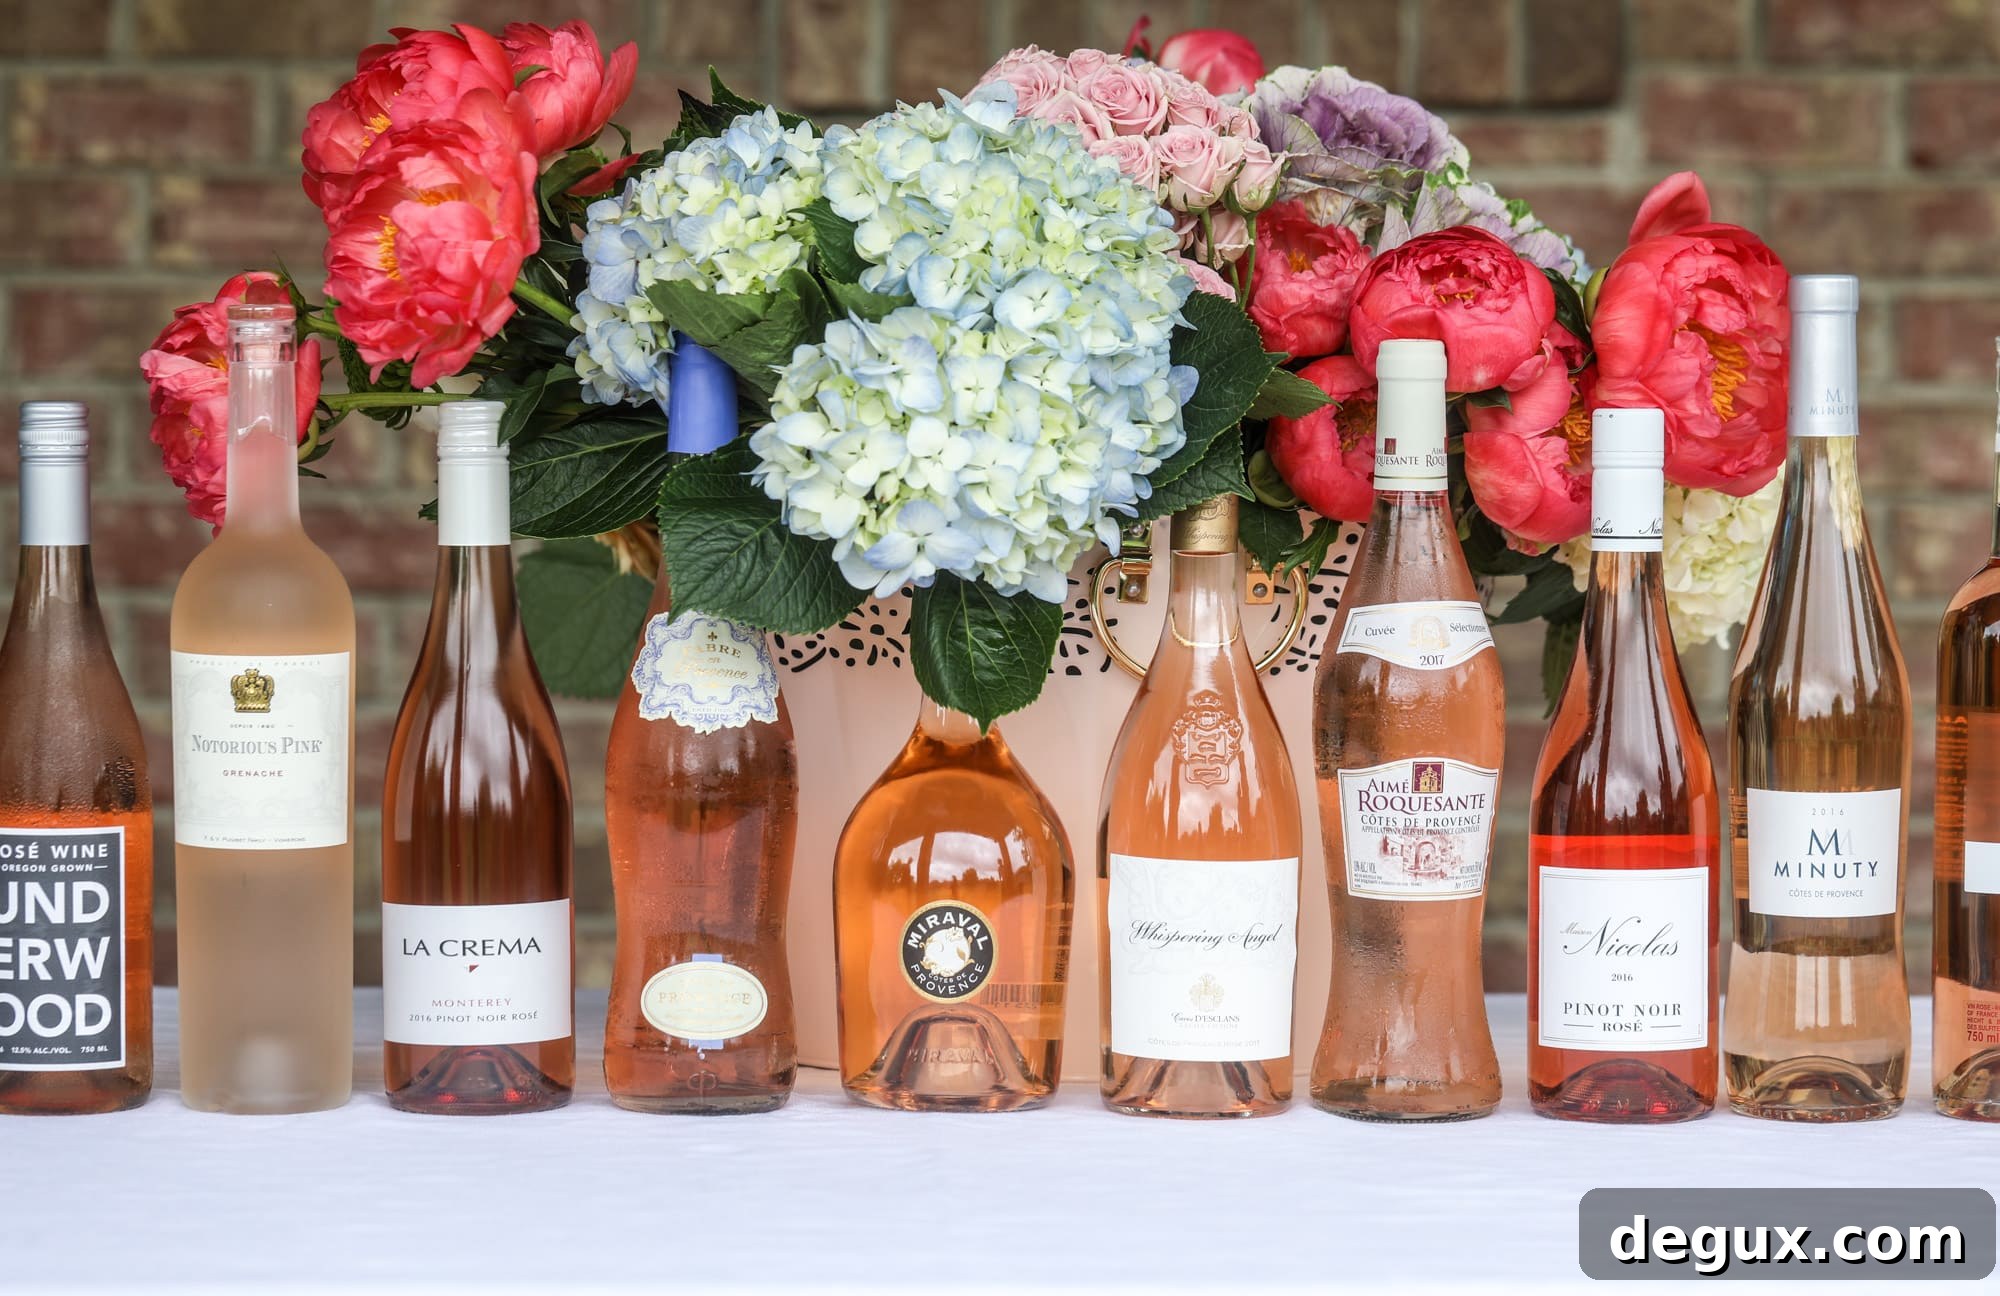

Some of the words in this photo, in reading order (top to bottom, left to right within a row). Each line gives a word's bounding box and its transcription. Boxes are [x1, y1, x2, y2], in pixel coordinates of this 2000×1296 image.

[1364, 626, 1396, 637] Cuvée
[1419, 655, 1445, 666] 2017
[192, 735, 277, 754] NOTORIOUS
[282, 736, 321, 754] PINK
[222, 769, 284, 777] GRENACHE
[1367, 778, 1409, 794] AIMÉ
[1358, 789, 1486, 815] ROQUESANTE
[1811, 808, 1845, 816] 2016
[1361, 814, 1398, 827] CÔTES
[1404, 818, 1419, 828] DE
[1425, 814, 1481, 828] PROVENCE
[50, 844, 108, 859] WINE
[1, 864, 46, 873] OREGON
[1774, 861, 1878, 879] MINUTY
[1814, 890, 1824, 898] DE
[1826, 889, 1864, 898] PROVENCE
[907, 911, 989, 951] MIRAVAL
[1128, 919, 1224, 951] Whispering
[1228, 922, 1284, 951] Angel
[1563, 916, 1680, 957] Nicolas
[403, 938, 431, 956] LA
[439, 937, 542, 957] CREMA
[911, 963, 985, 995] PROVENCE
[1611, 973, 1634, 982] 2016
[431, 998, 512, 1008] MONTEREY
[1563, 1002, 1624, 1017] PINOT
[1634, 1003, 1681, 1017] NOIR
[409, 1013, 432, 1022] 2016
[436, 1014, 470, 1023] PINOT
[477, 1014, 506, 1022] NOIR
[512, 1010, 538, 1021] ROSÉ
[1602, 1019, 1643, 1032] ROSÉ
[1967, 1031, 1984, 1042] 750
[1987, 1033, 2000, 1043] ml
[80, 1046, 95, 1054] 750
[97, 1045, 108, 1053] ML
